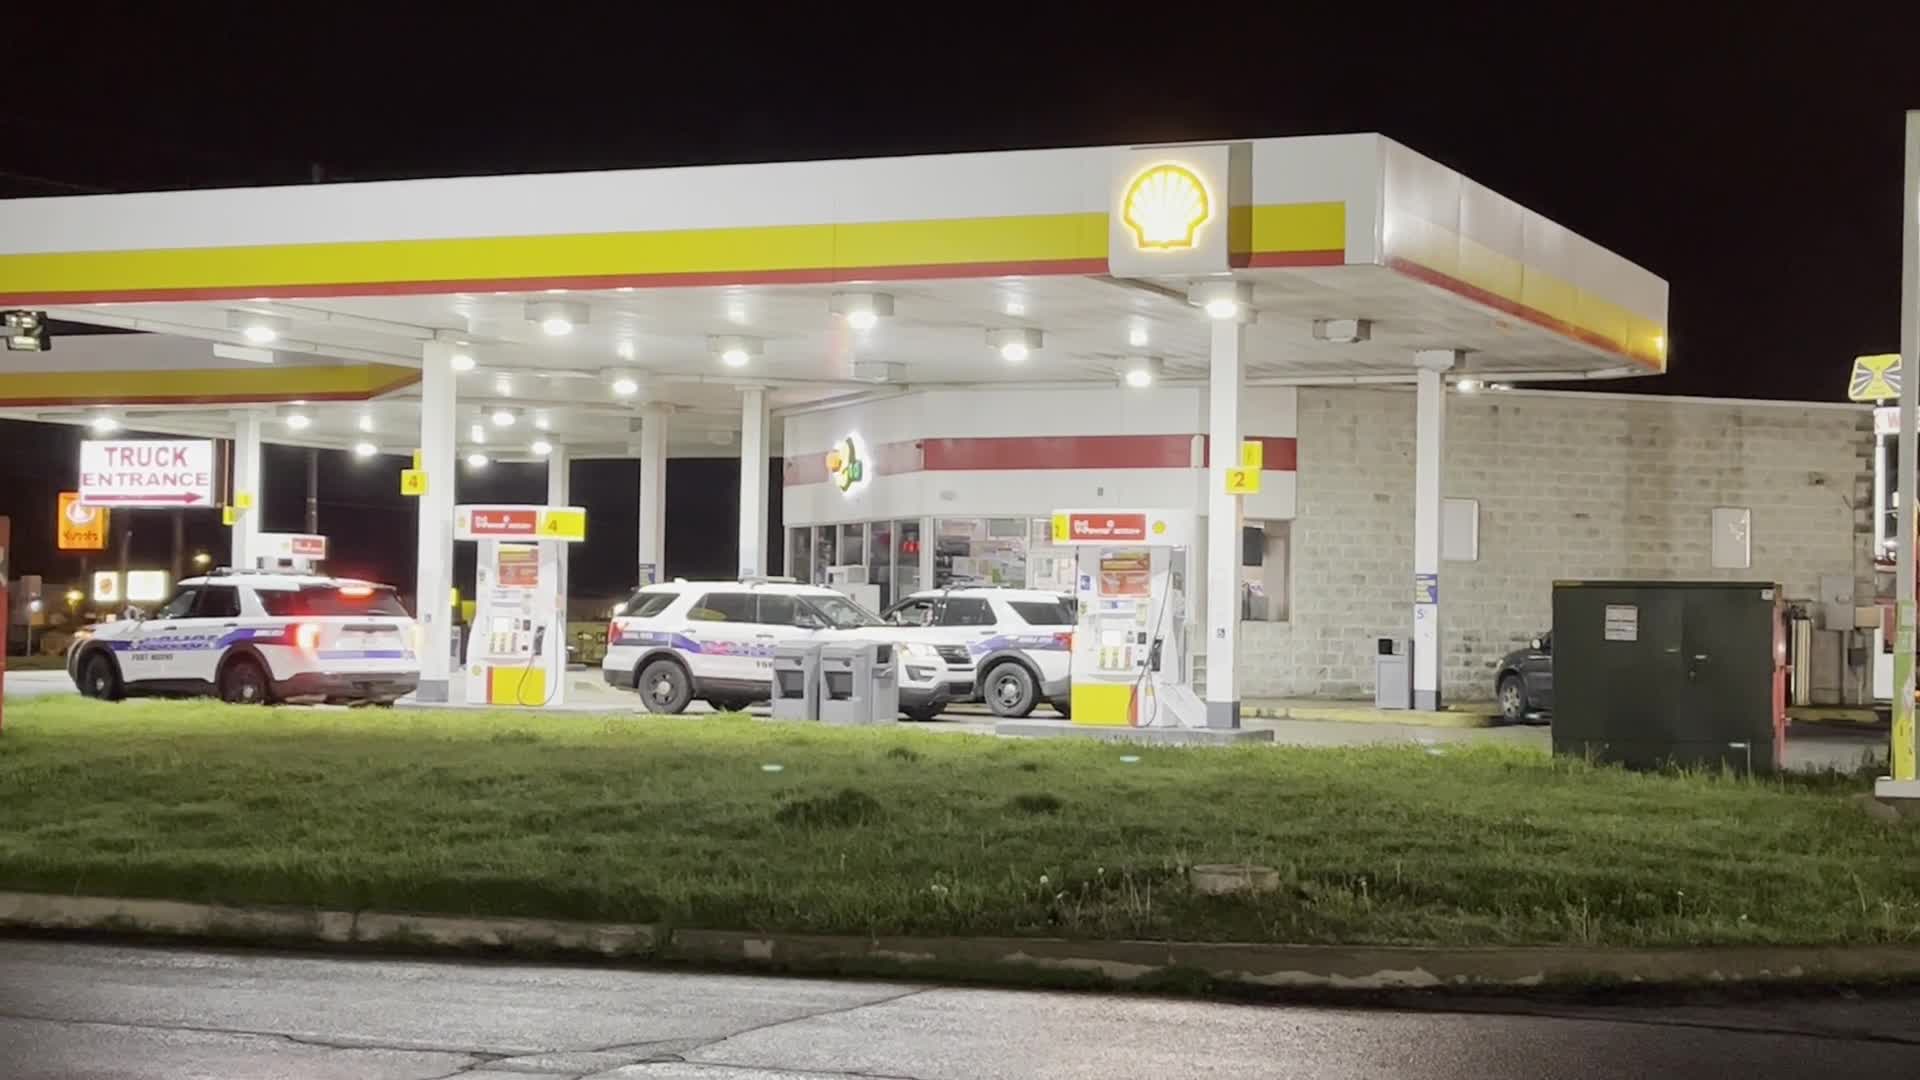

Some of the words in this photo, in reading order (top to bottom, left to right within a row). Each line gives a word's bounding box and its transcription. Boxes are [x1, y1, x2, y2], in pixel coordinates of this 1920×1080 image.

[104, 447, 189, 467] TRUCK
[82, 472, 209, 487] ENTRANCE
[408, 475, 418, 488] 4
[1234, 472, 1246, 487] 2
[547, 519, 559, 532] 4
